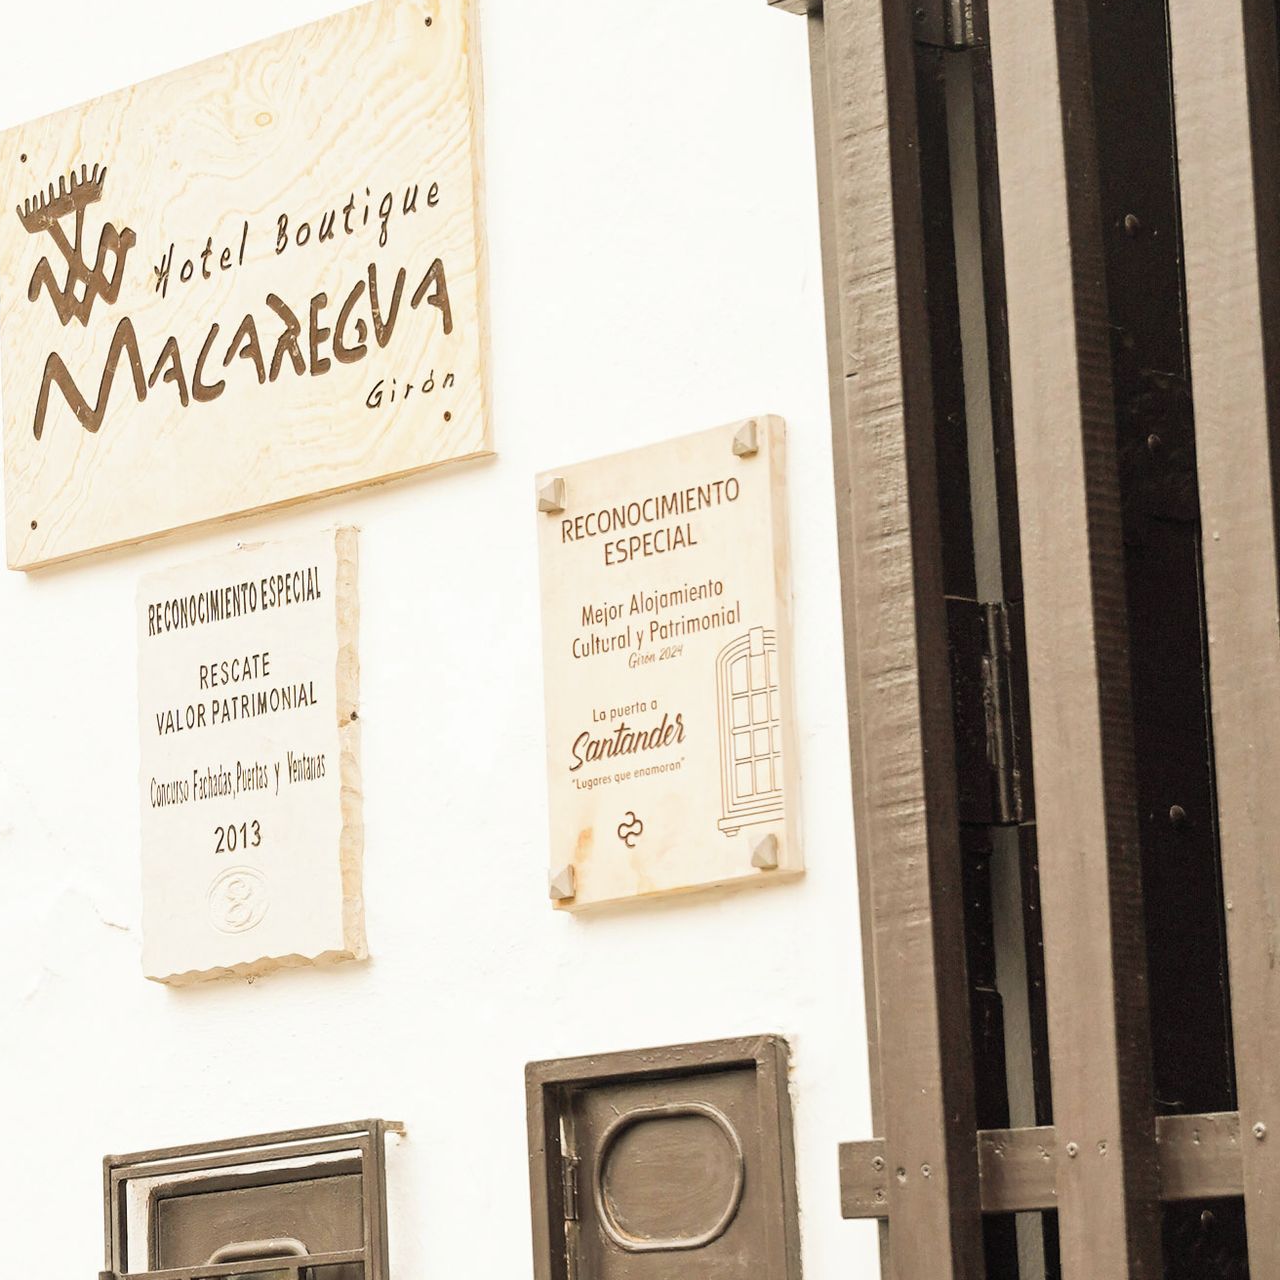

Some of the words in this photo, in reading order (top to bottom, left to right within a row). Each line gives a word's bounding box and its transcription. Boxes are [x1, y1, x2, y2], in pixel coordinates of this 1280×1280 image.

[153, 220, 249, 300] Hotel
[274, 181, 441, 256] Boutique
[365, 368, 455, 410] Girón
[561, 476, 740, 544] RECONOCIMIENTO
[603, 522, 699, 567] ESPECIAL
[147, 581, 258, 637] RECONOCIMIENTO
[260, 565, 322, 612] ESPECIAL
[580, 602, 625, 628] Mejor
[629, 578, 724, 617] Alojamiento
[572, 624, 631, 660] Cultural
[636, 629, 645, 651] y
[649, 599, 742, 644] Patrimonial
[199, 651, 271, 691] RESCATE
[155, 704, 207, 736] VALOR
[211, 680, 318, 726] PATRIMONIAL
[592, 708, 607, 723] La
[609, 702, 647, 723] puerta
[650, 699, 658, 711] a
[568, 712, 687, 773] Santander
[150, 776, 190, 809] Concurso
[273, 761, 280, 797] y
[286, 750, 326, 785] Ventanas
[613, 771, 632, 785] que
[213, 819, 262, 855] 2013
